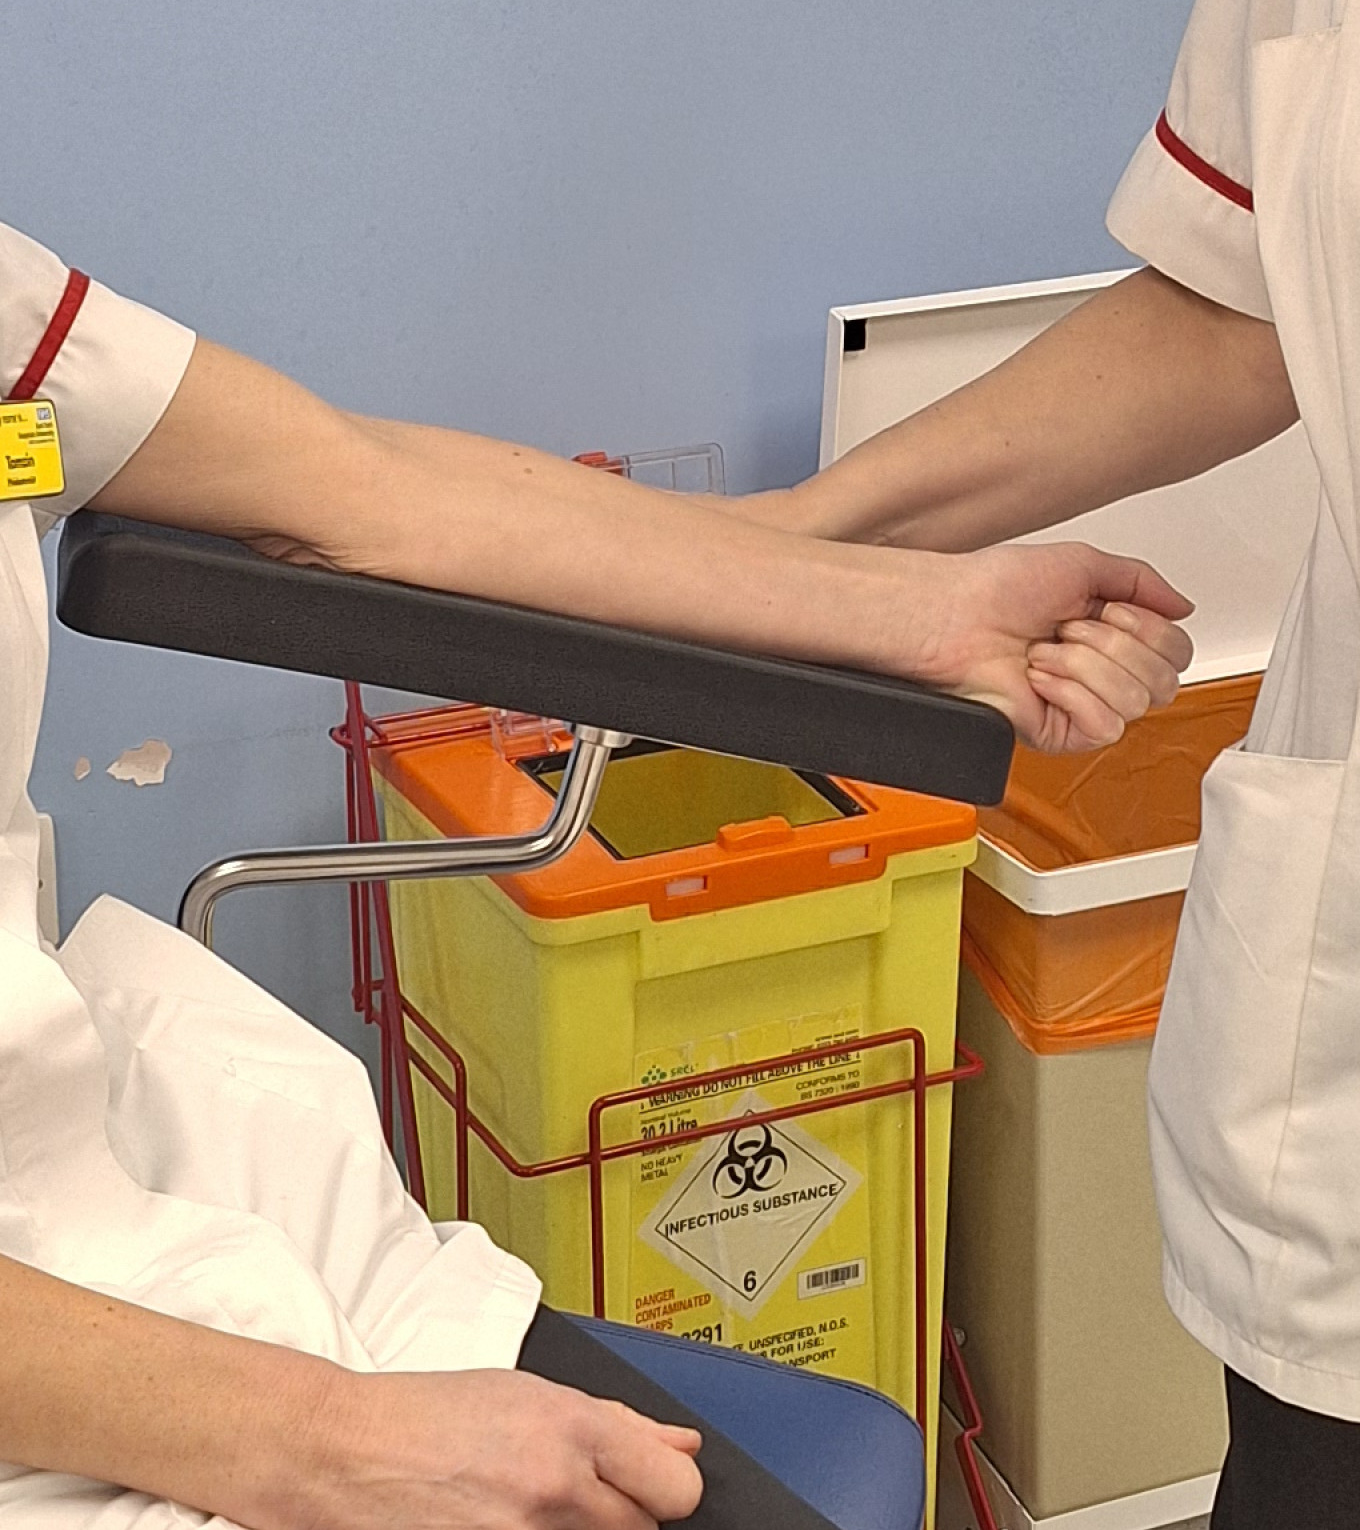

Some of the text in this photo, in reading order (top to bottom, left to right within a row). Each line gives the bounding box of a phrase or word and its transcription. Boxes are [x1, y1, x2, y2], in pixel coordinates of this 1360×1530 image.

[848, 1070, 860, 1079] TO
[665, 1183, 839, 1238] INFECTIOUS SUBSTANCE
[743, 1271, 757, 1292] 6
[635, 1289, 675, 1309] DANGER
[635, 1293, 712, 1324] CONTAMINATED
[771, 1343, 794, 1357] FOR
